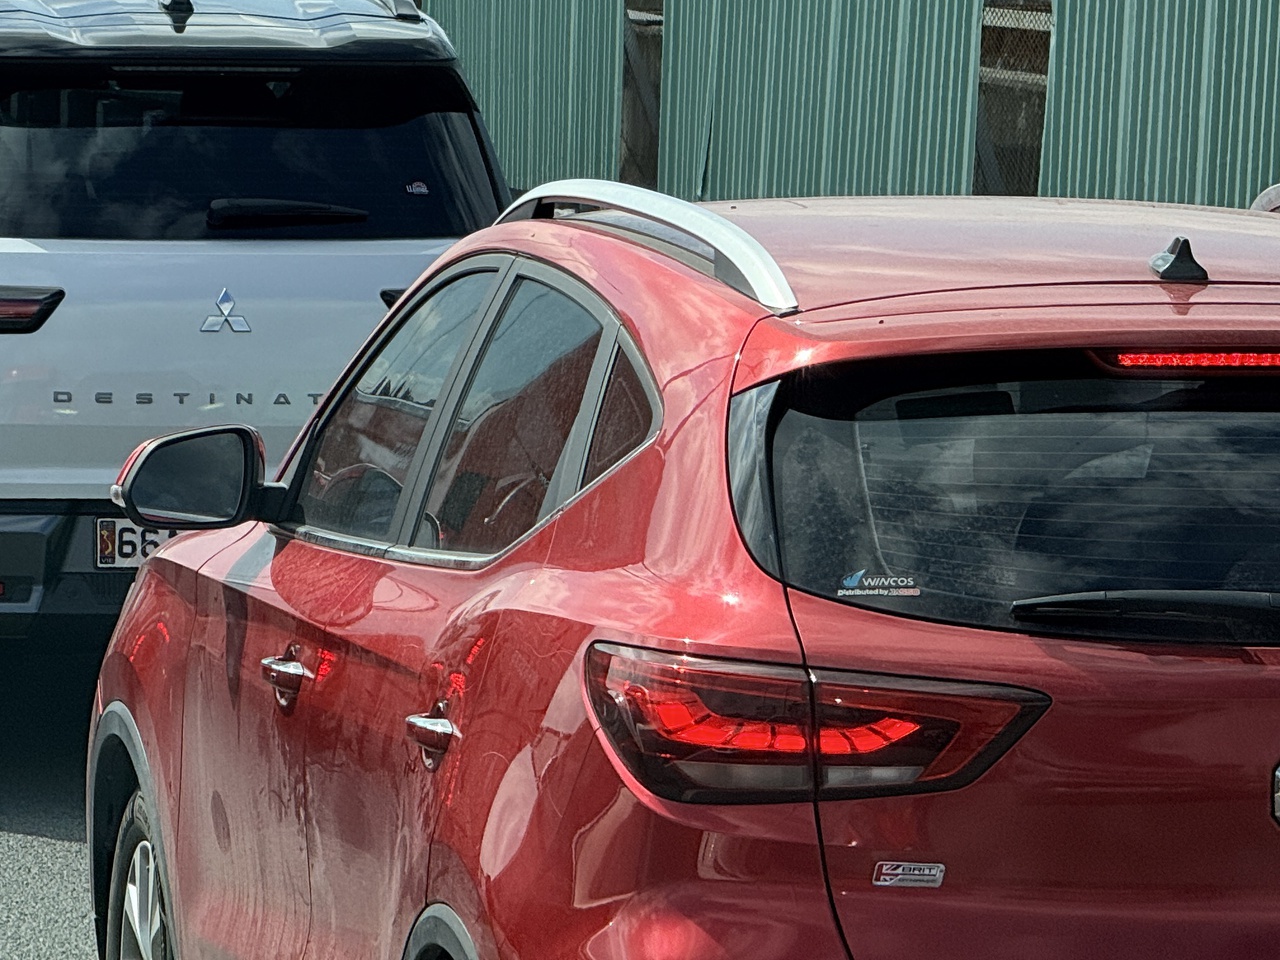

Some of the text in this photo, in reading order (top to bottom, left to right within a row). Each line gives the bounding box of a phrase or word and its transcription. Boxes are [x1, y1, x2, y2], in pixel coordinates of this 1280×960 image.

[862, 577, 914, 586] WINCOS
[837, 588, 878, 596] Distributed
[879, 588, 889, 596] by
